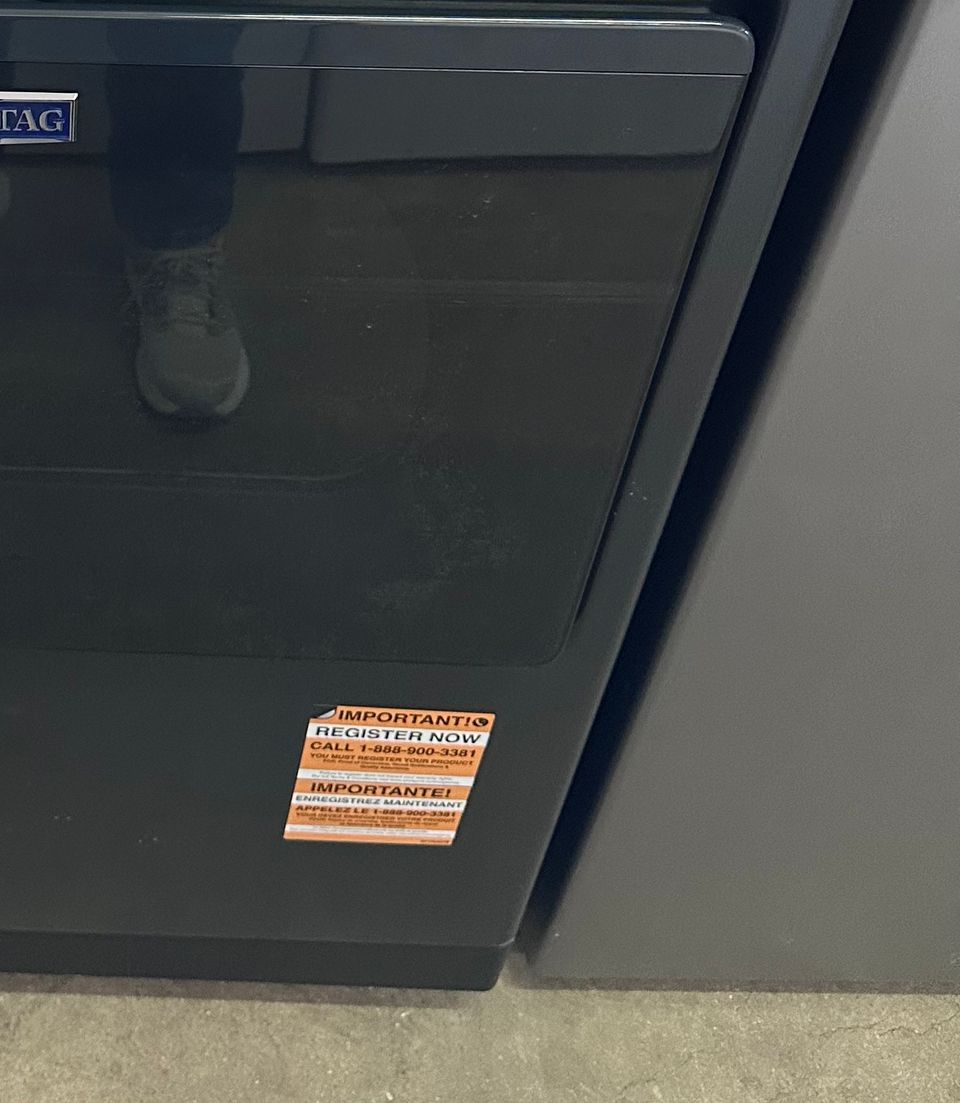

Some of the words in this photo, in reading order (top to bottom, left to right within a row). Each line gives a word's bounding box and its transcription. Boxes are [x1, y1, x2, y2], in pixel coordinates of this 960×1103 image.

[338, 710, 471, 727] IMPORTANT!
[316, 726, 423, 741] REGISTER
[429, 732, 481, 744] NOW
[310, 741, 354, 752] CALL
[360, 744, 476, 757] 1-888-900-3381
[430, 758, 474, 766] PRODUCT
[310, 782, 452, 798] IMPORTANTE!
[295, 795, 381, 805] ENREGISTREZ
[383, 799, 464, 808] MAINTENANT
[295, 804, 352, 813] APPELEZ
[353, 806, 369, 814] LE
[373, 808, 457, 818] 1-888-900-3381
